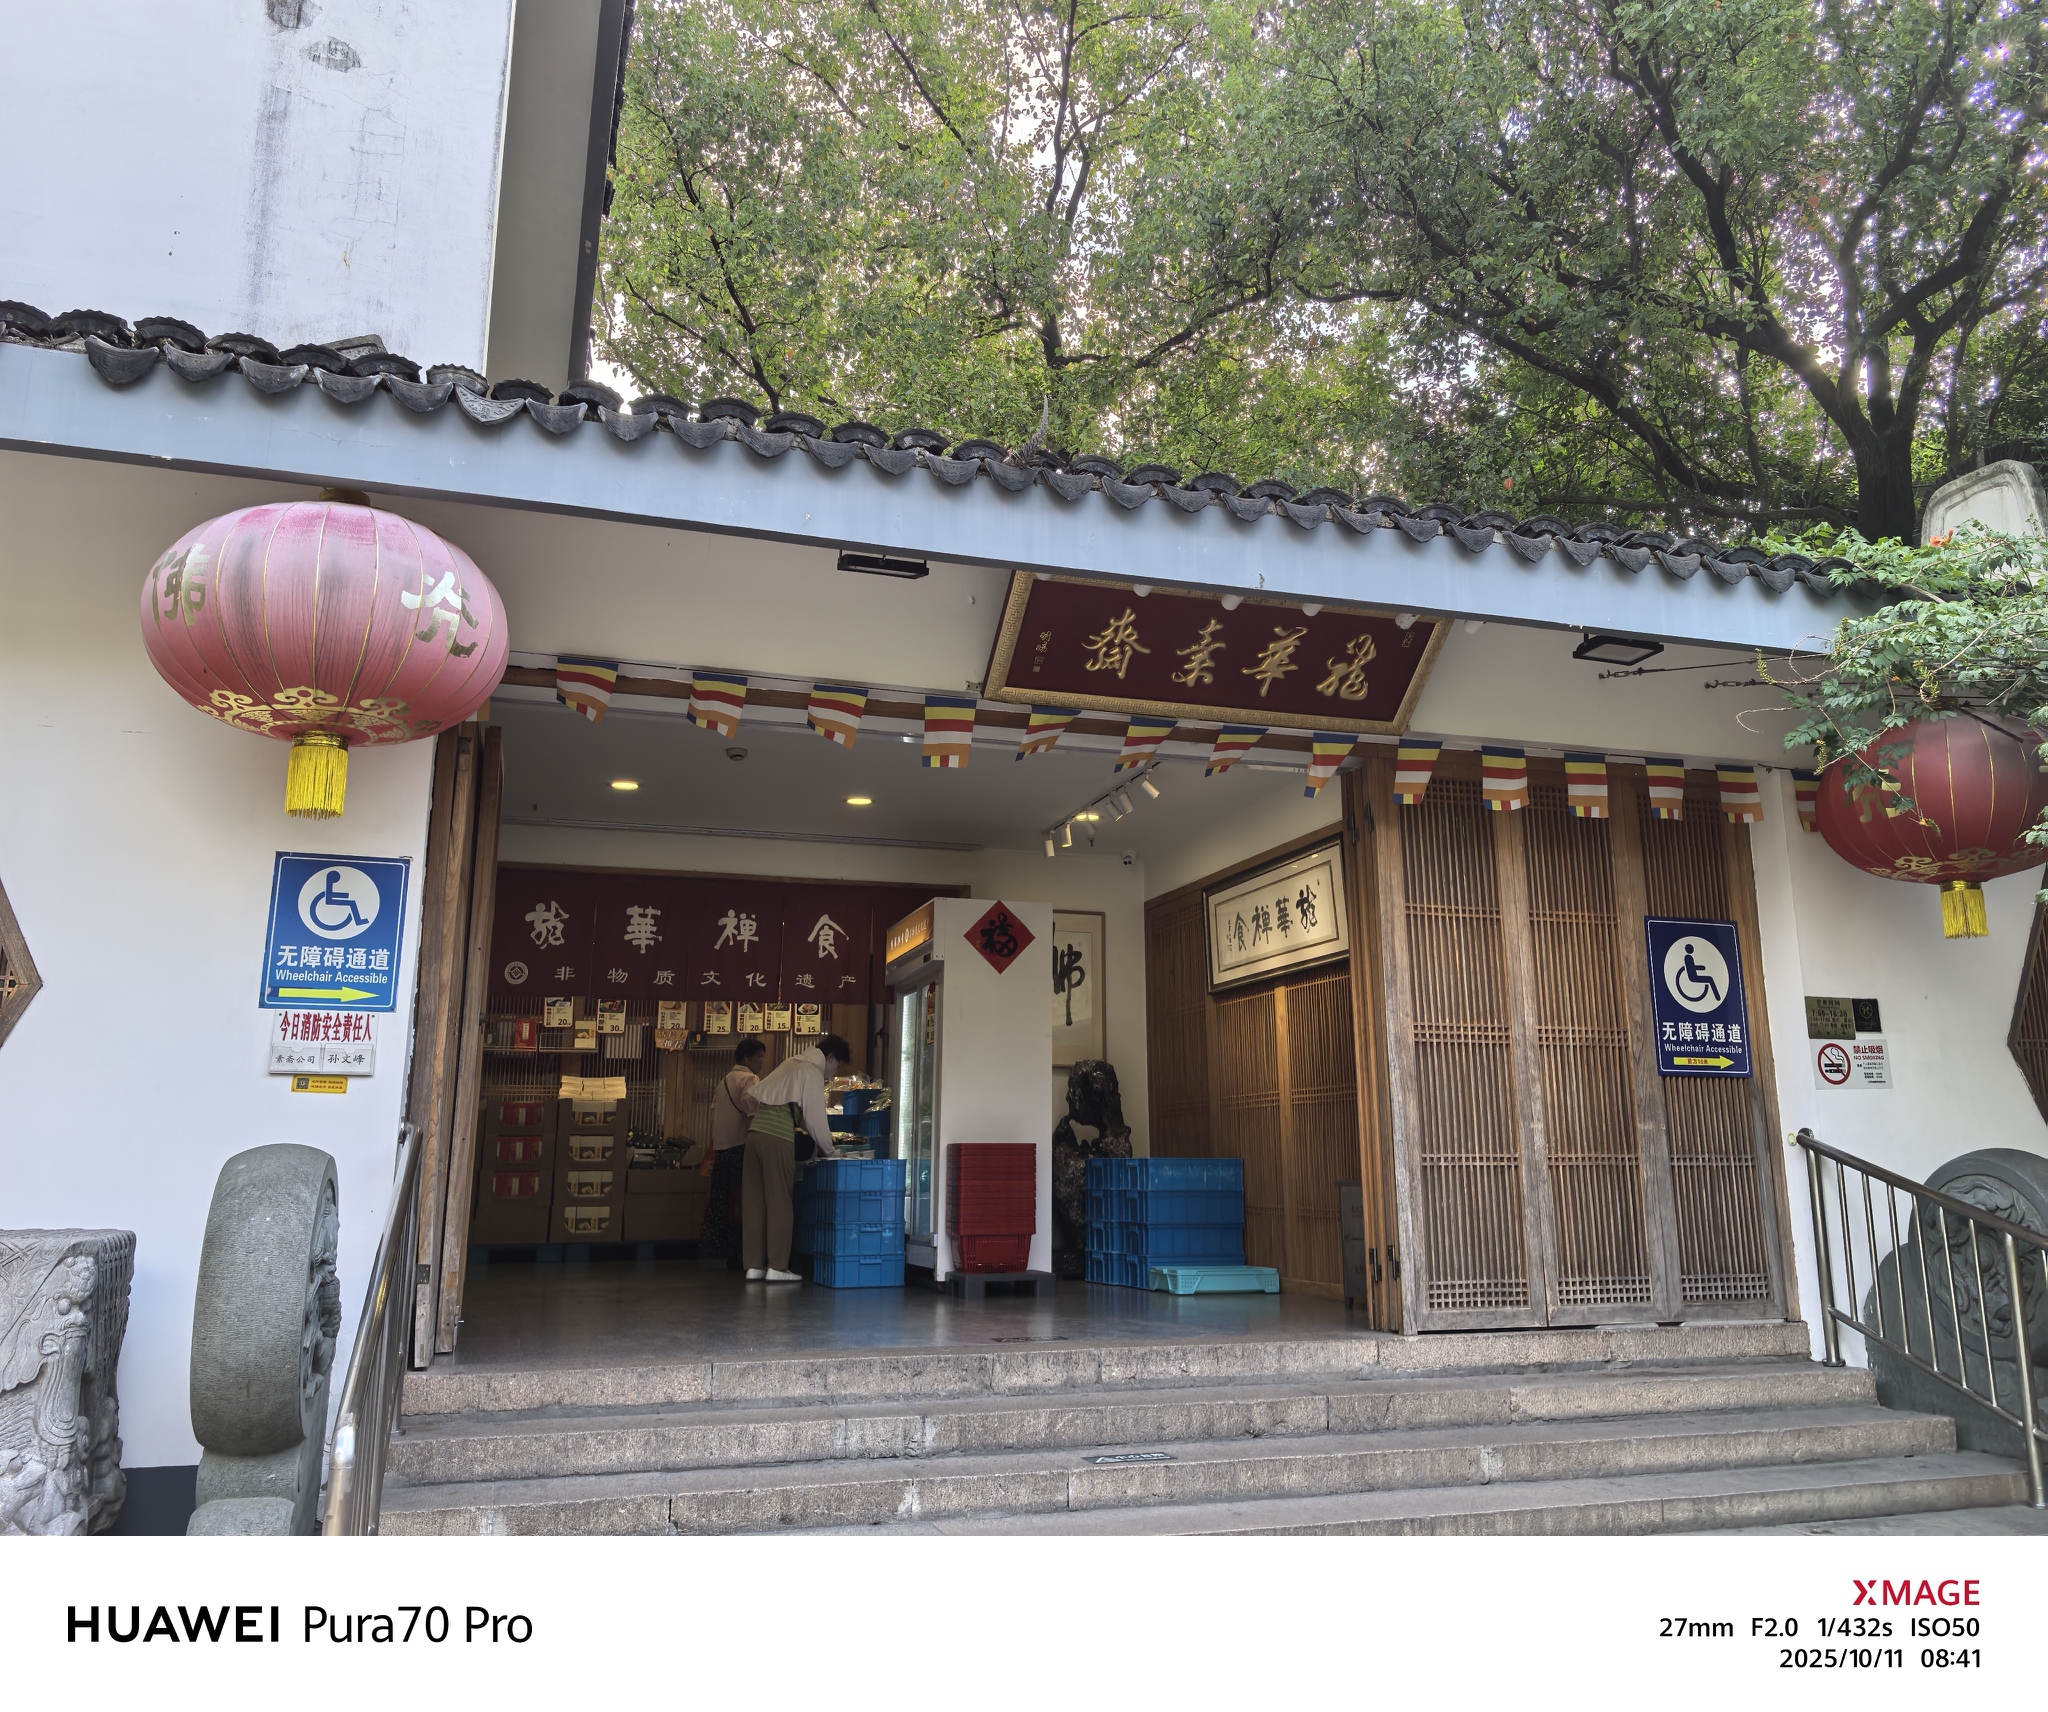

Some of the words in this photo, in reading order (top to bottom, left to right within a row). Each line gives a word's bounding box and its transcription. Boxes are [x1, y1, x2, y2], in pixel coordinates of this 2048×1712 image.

[979, 911, 1019, 958] 福
[275, 945, 391, 971] 无障碍通道
[275, 969, 333, 982] Wheelchair
[335, 972, 388, 984] Accessible
[554, 966, 857, 990] 非物质文化遗产
[279, 1011, 372, 1043] 今日消防安全责任人
[1662, 1022, 1742, 1043] 无障碍通道
[327, 1053, 366, 1066] 孙文峰
[1664, 1044, 1704, 1053] Wheelchair
[1706, 1045, 1742, 1054] Accessible
[1853, 1045, 1884, 1054] 禁止吸烟
